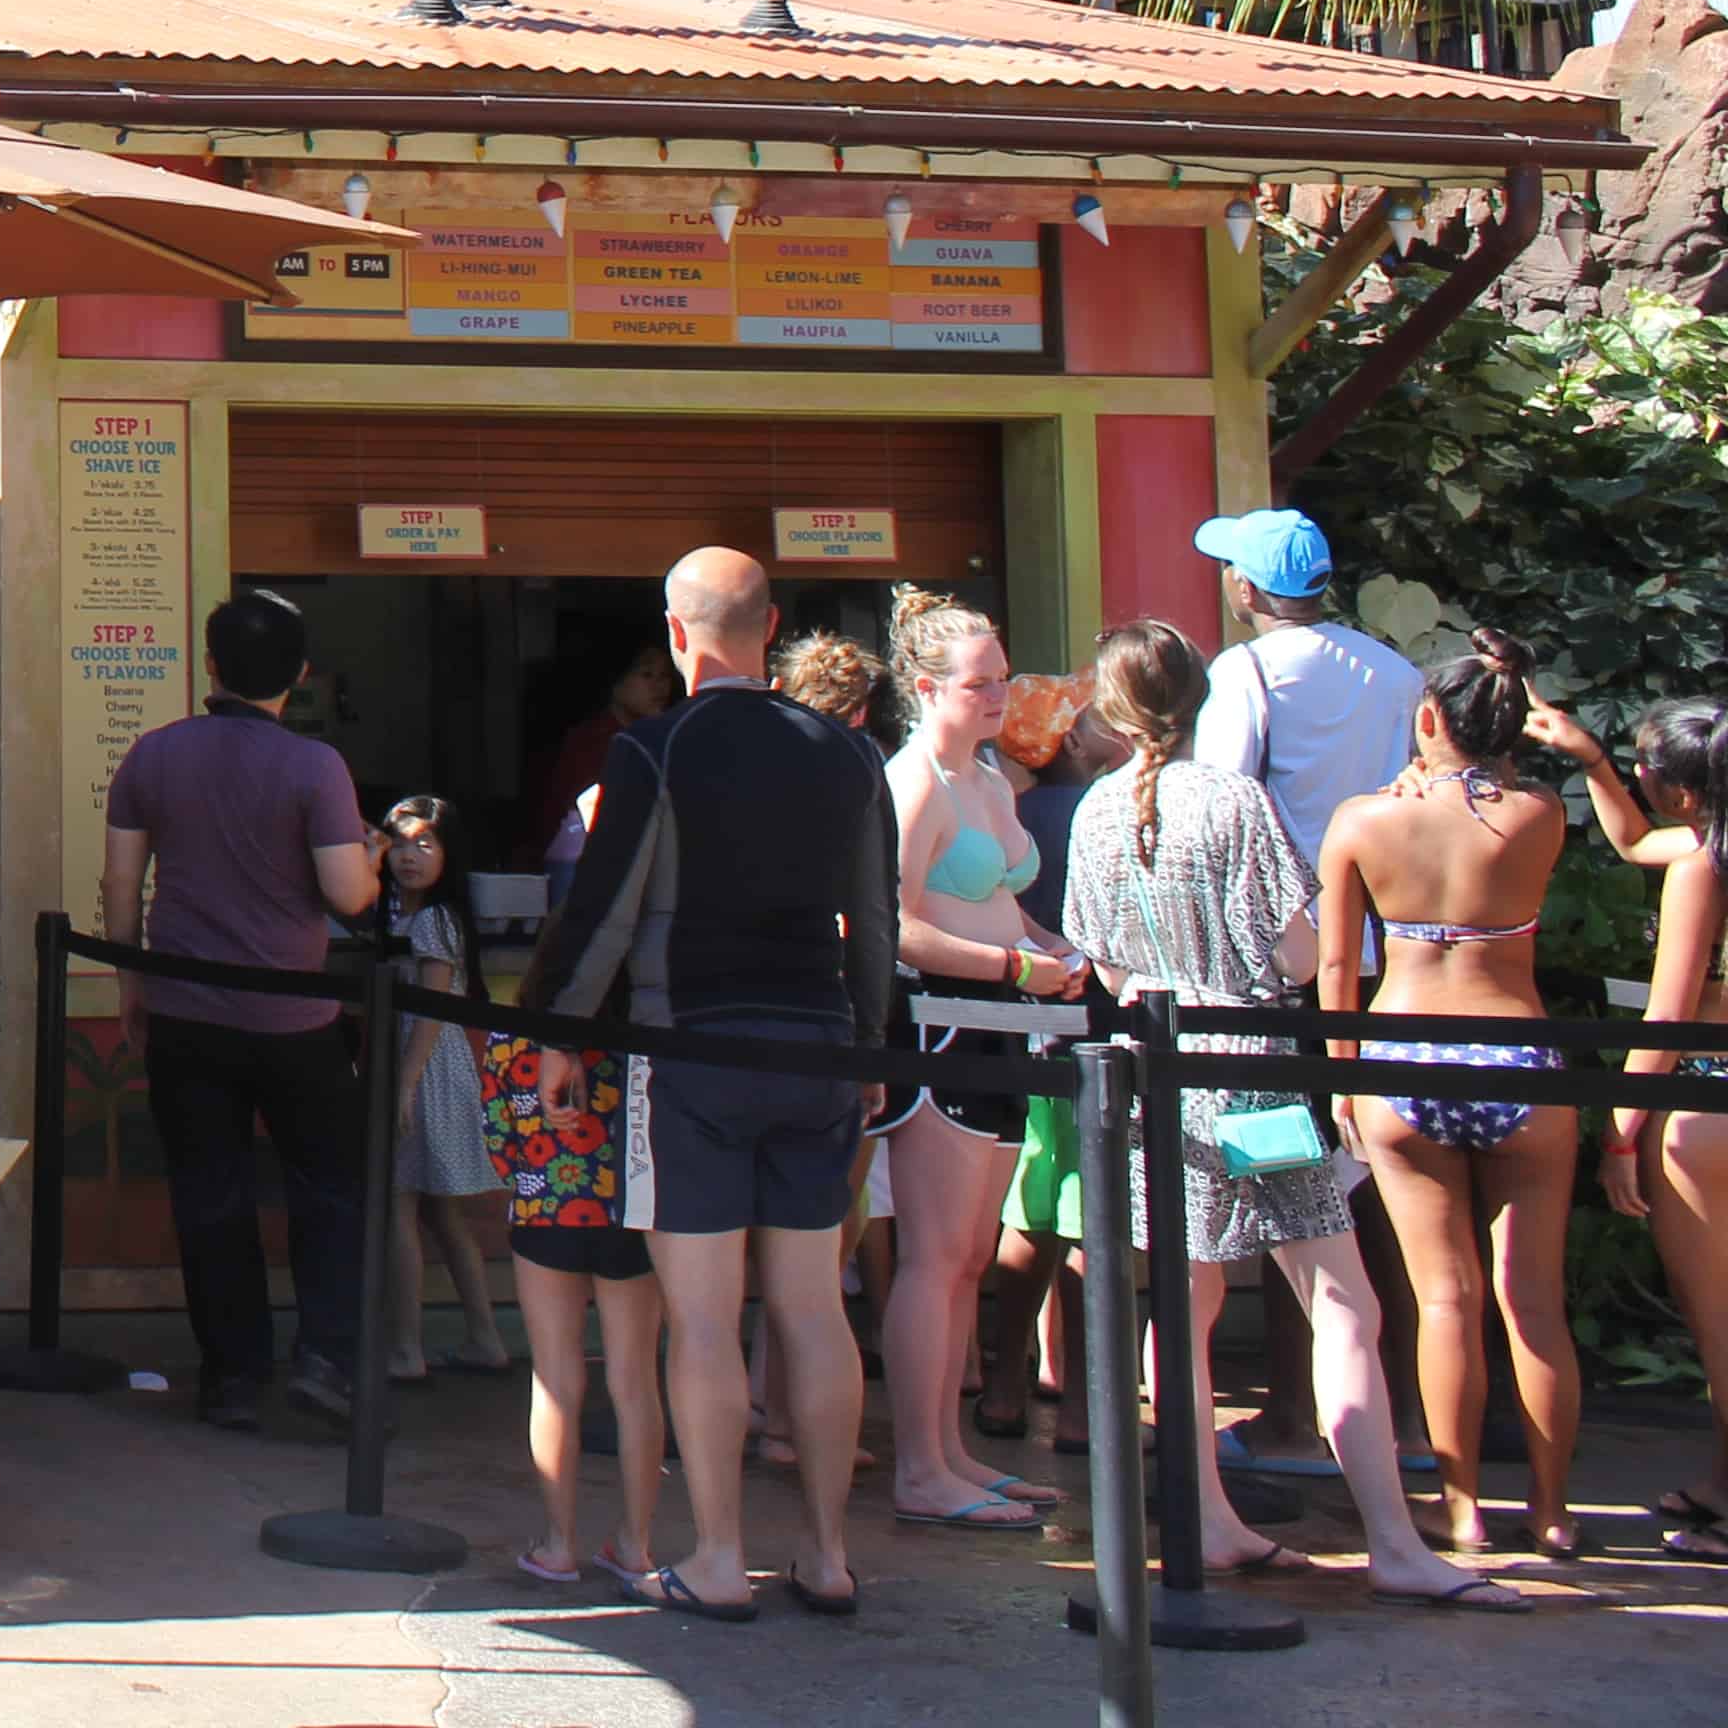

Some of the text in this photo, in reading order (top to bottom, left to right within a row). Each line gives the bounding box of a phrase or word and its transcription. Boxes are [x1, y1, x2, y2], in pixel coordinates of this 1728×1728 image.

[935, 219, 994, 234] CHERRY
[432, 234, 544, 250] WATERMELON
[599, 238, 705, 254] STRAWBERRY
[778, 243, 849, 258] ORANGE
[935, 246, 994, 261] GUAVA
[282, 256, 305, 271] AM
[318, 257, 337, 272] TO
[351, 258, 361, 272] 5
[363, 258, 386, 273] PM
[440, 262, 537, 277] LI-HING-MUI
[604, 265, 703, 282] GREEN TEA
[765, 270, 864, 286] LEMON-LIME
[932, 273, 1002, 289] BANANA
[456, 288, 522, 304] MANGO
[619, 293, 689, 309] LYCHEE
[785, 297, 843, 313] LILIKOI
[923, 303, 1012, 319] ROOT BEER
[458, 315, 521, 331] GRAPE
[612, 320, 697, 337] PINEAPPLE
[782, 323, 848, 339] HAUPIA
[935, 330, 1001, 346] VANILLA
[95, 417, 152, 436] STEP 1
[70, 440, 177, 457] CHOOSE YOUR
[85, 459, 161, 474] SHAVE ICE
[400, 511, 433, 525] STEP
[812, 515, 844, 528] STEP
[385, 528, 424, 539] ORDER
[437, 528, 461, 538] PAY
[788, 531, 883, 543] CHOOSE FLAVORS
[409, 541, 438, 553] HERE
[93, 625, 155, 643] STEP 2
[71, 647, 178, 662] CHOOSE YOUR
[96, 665, 166, 681] FLAVORS
[105, 701, 143, 714] Cherry
[629, 1055, 649, 1181] AUTICA
